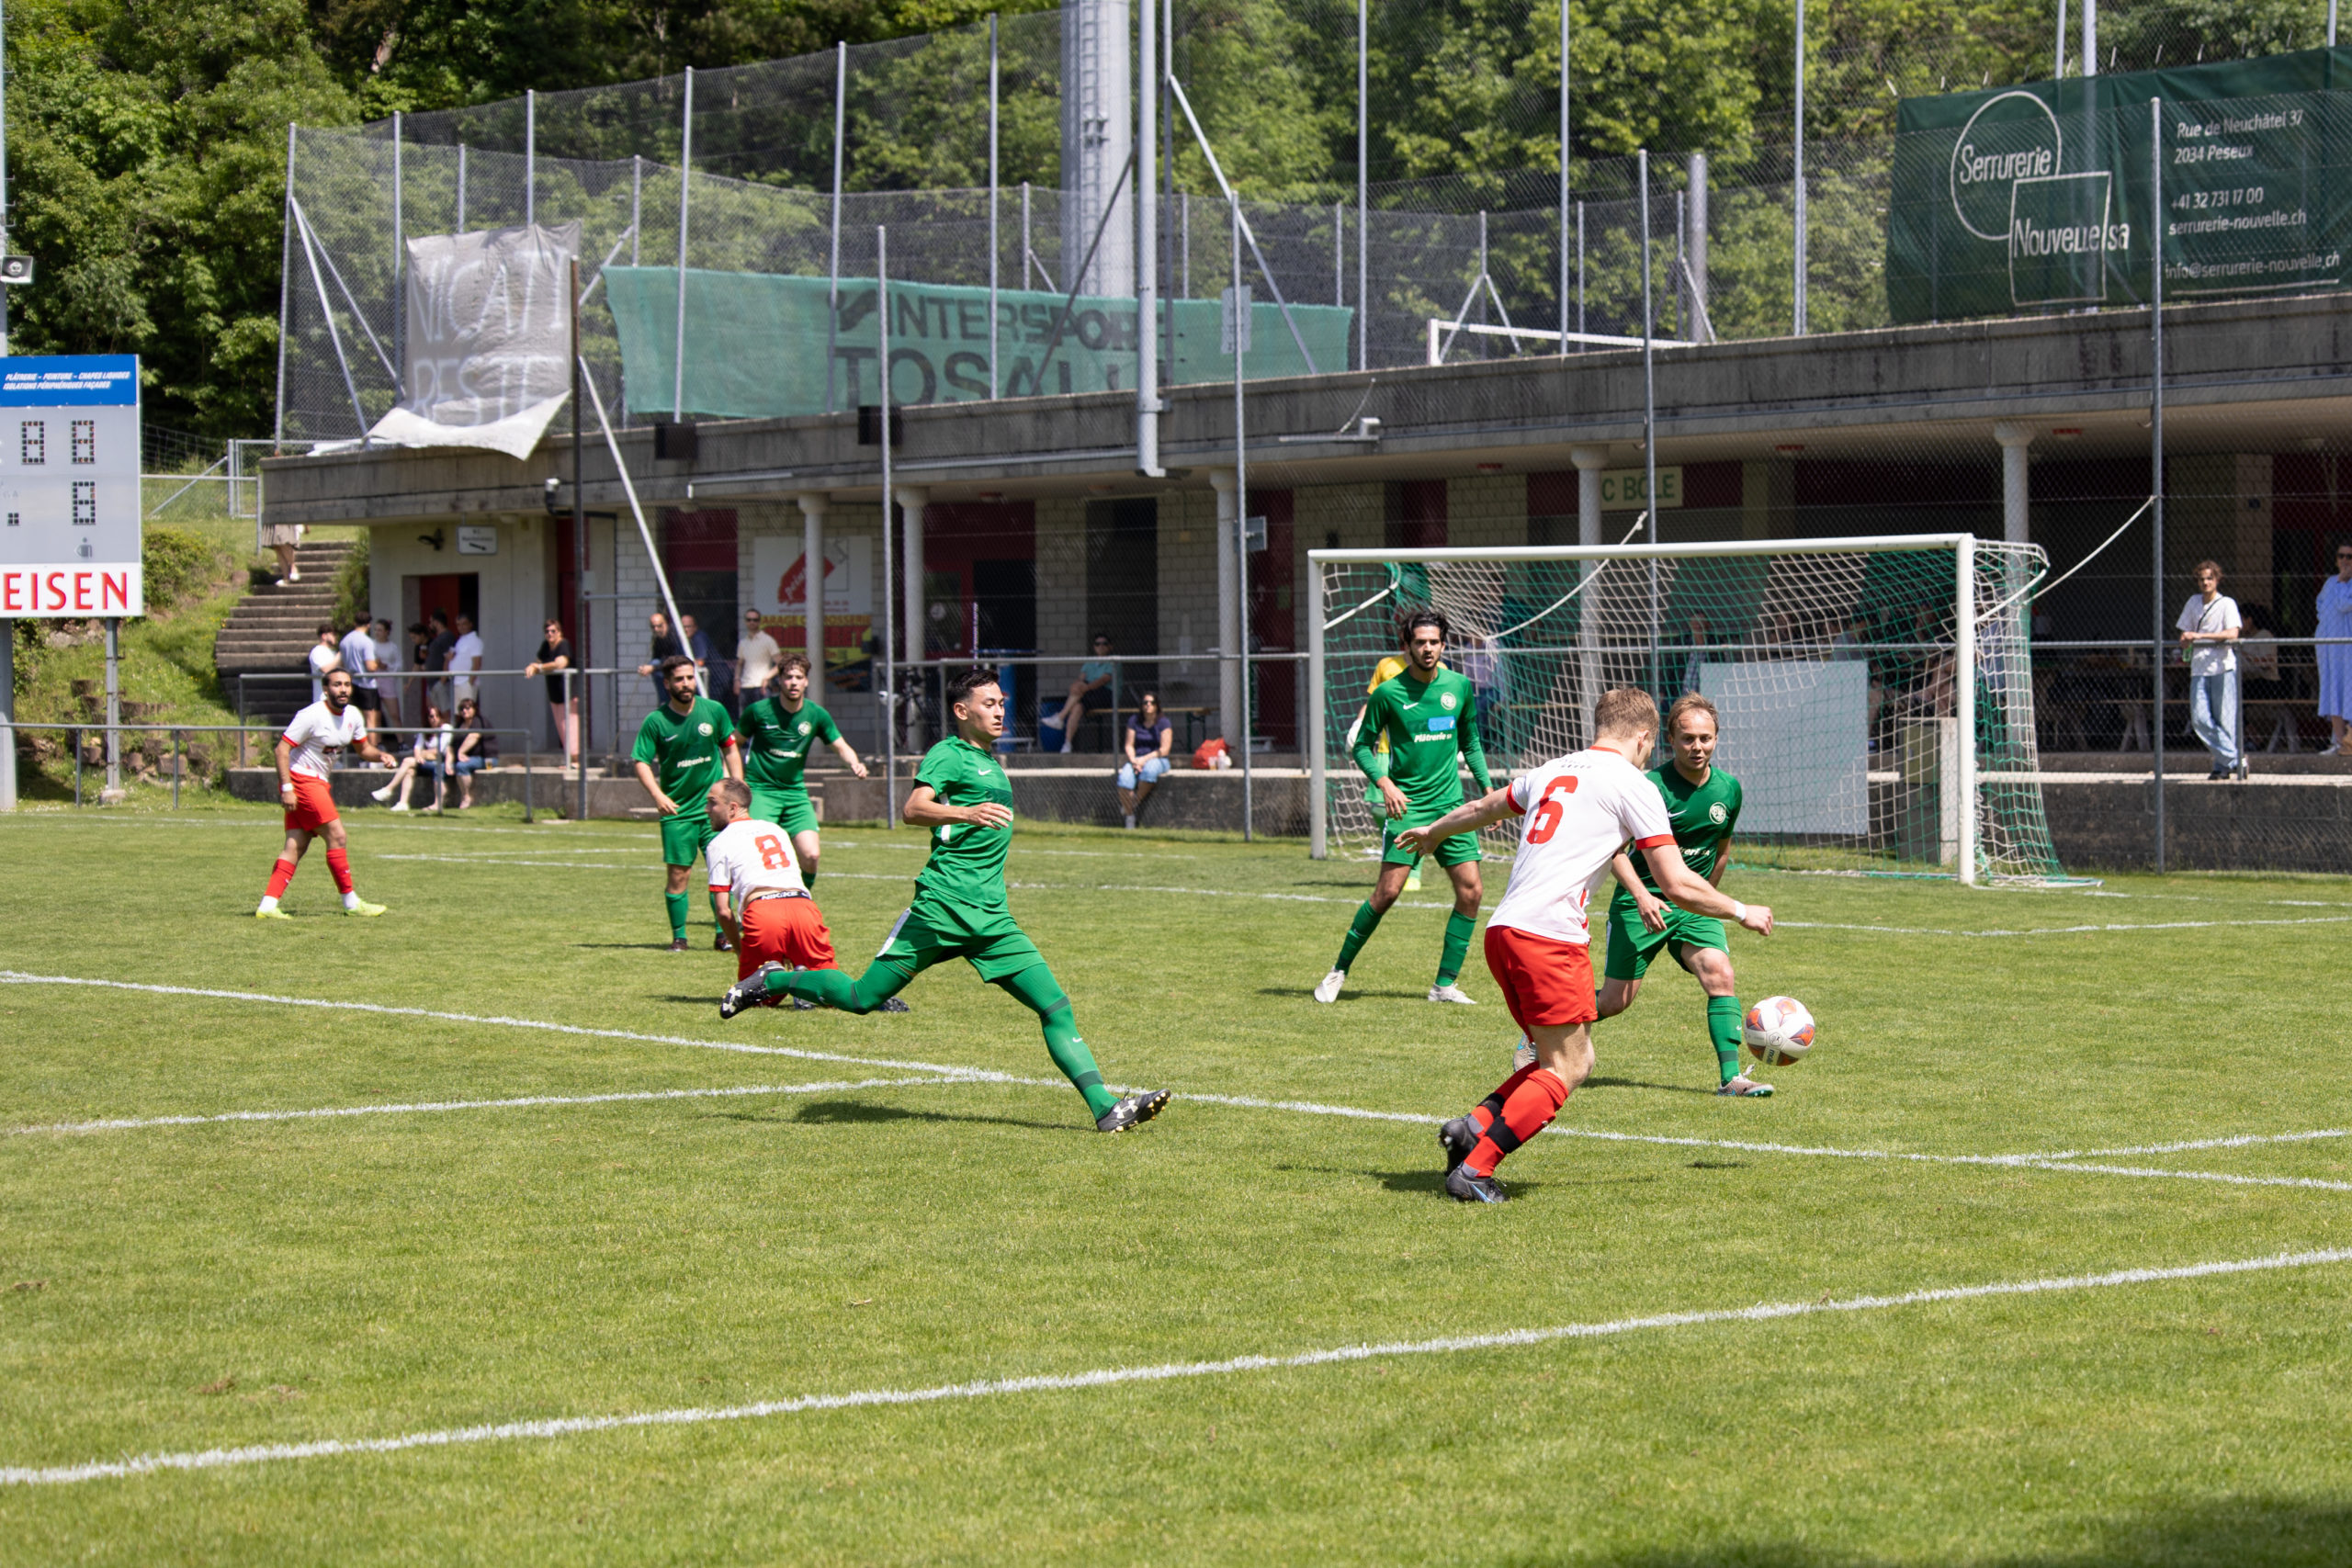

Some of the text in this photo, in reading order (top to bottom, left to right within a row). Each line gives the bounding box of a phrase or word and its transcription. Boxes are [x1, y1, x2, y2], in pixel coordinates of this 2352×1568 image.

[2177, 108, 2304, 139] Rue de Neuchâtel 37
[1960, 144, 2052, 185] Serrurerie
[2174, 144, 2254, 164] 2034 Peseux
[2171, 186, 2265, 210] +41 32 731 17 00
[2168, 209, 2307, 236] serrurerie-nouvelle.ch
[2165, 250, 2340, 279] info@serrurerie-nouvelle.ch
[886, 284, 1165, 353] INTERSPOR
[1526, 775, 1578, 844] 6
[754, 834, 791, 871] 8
